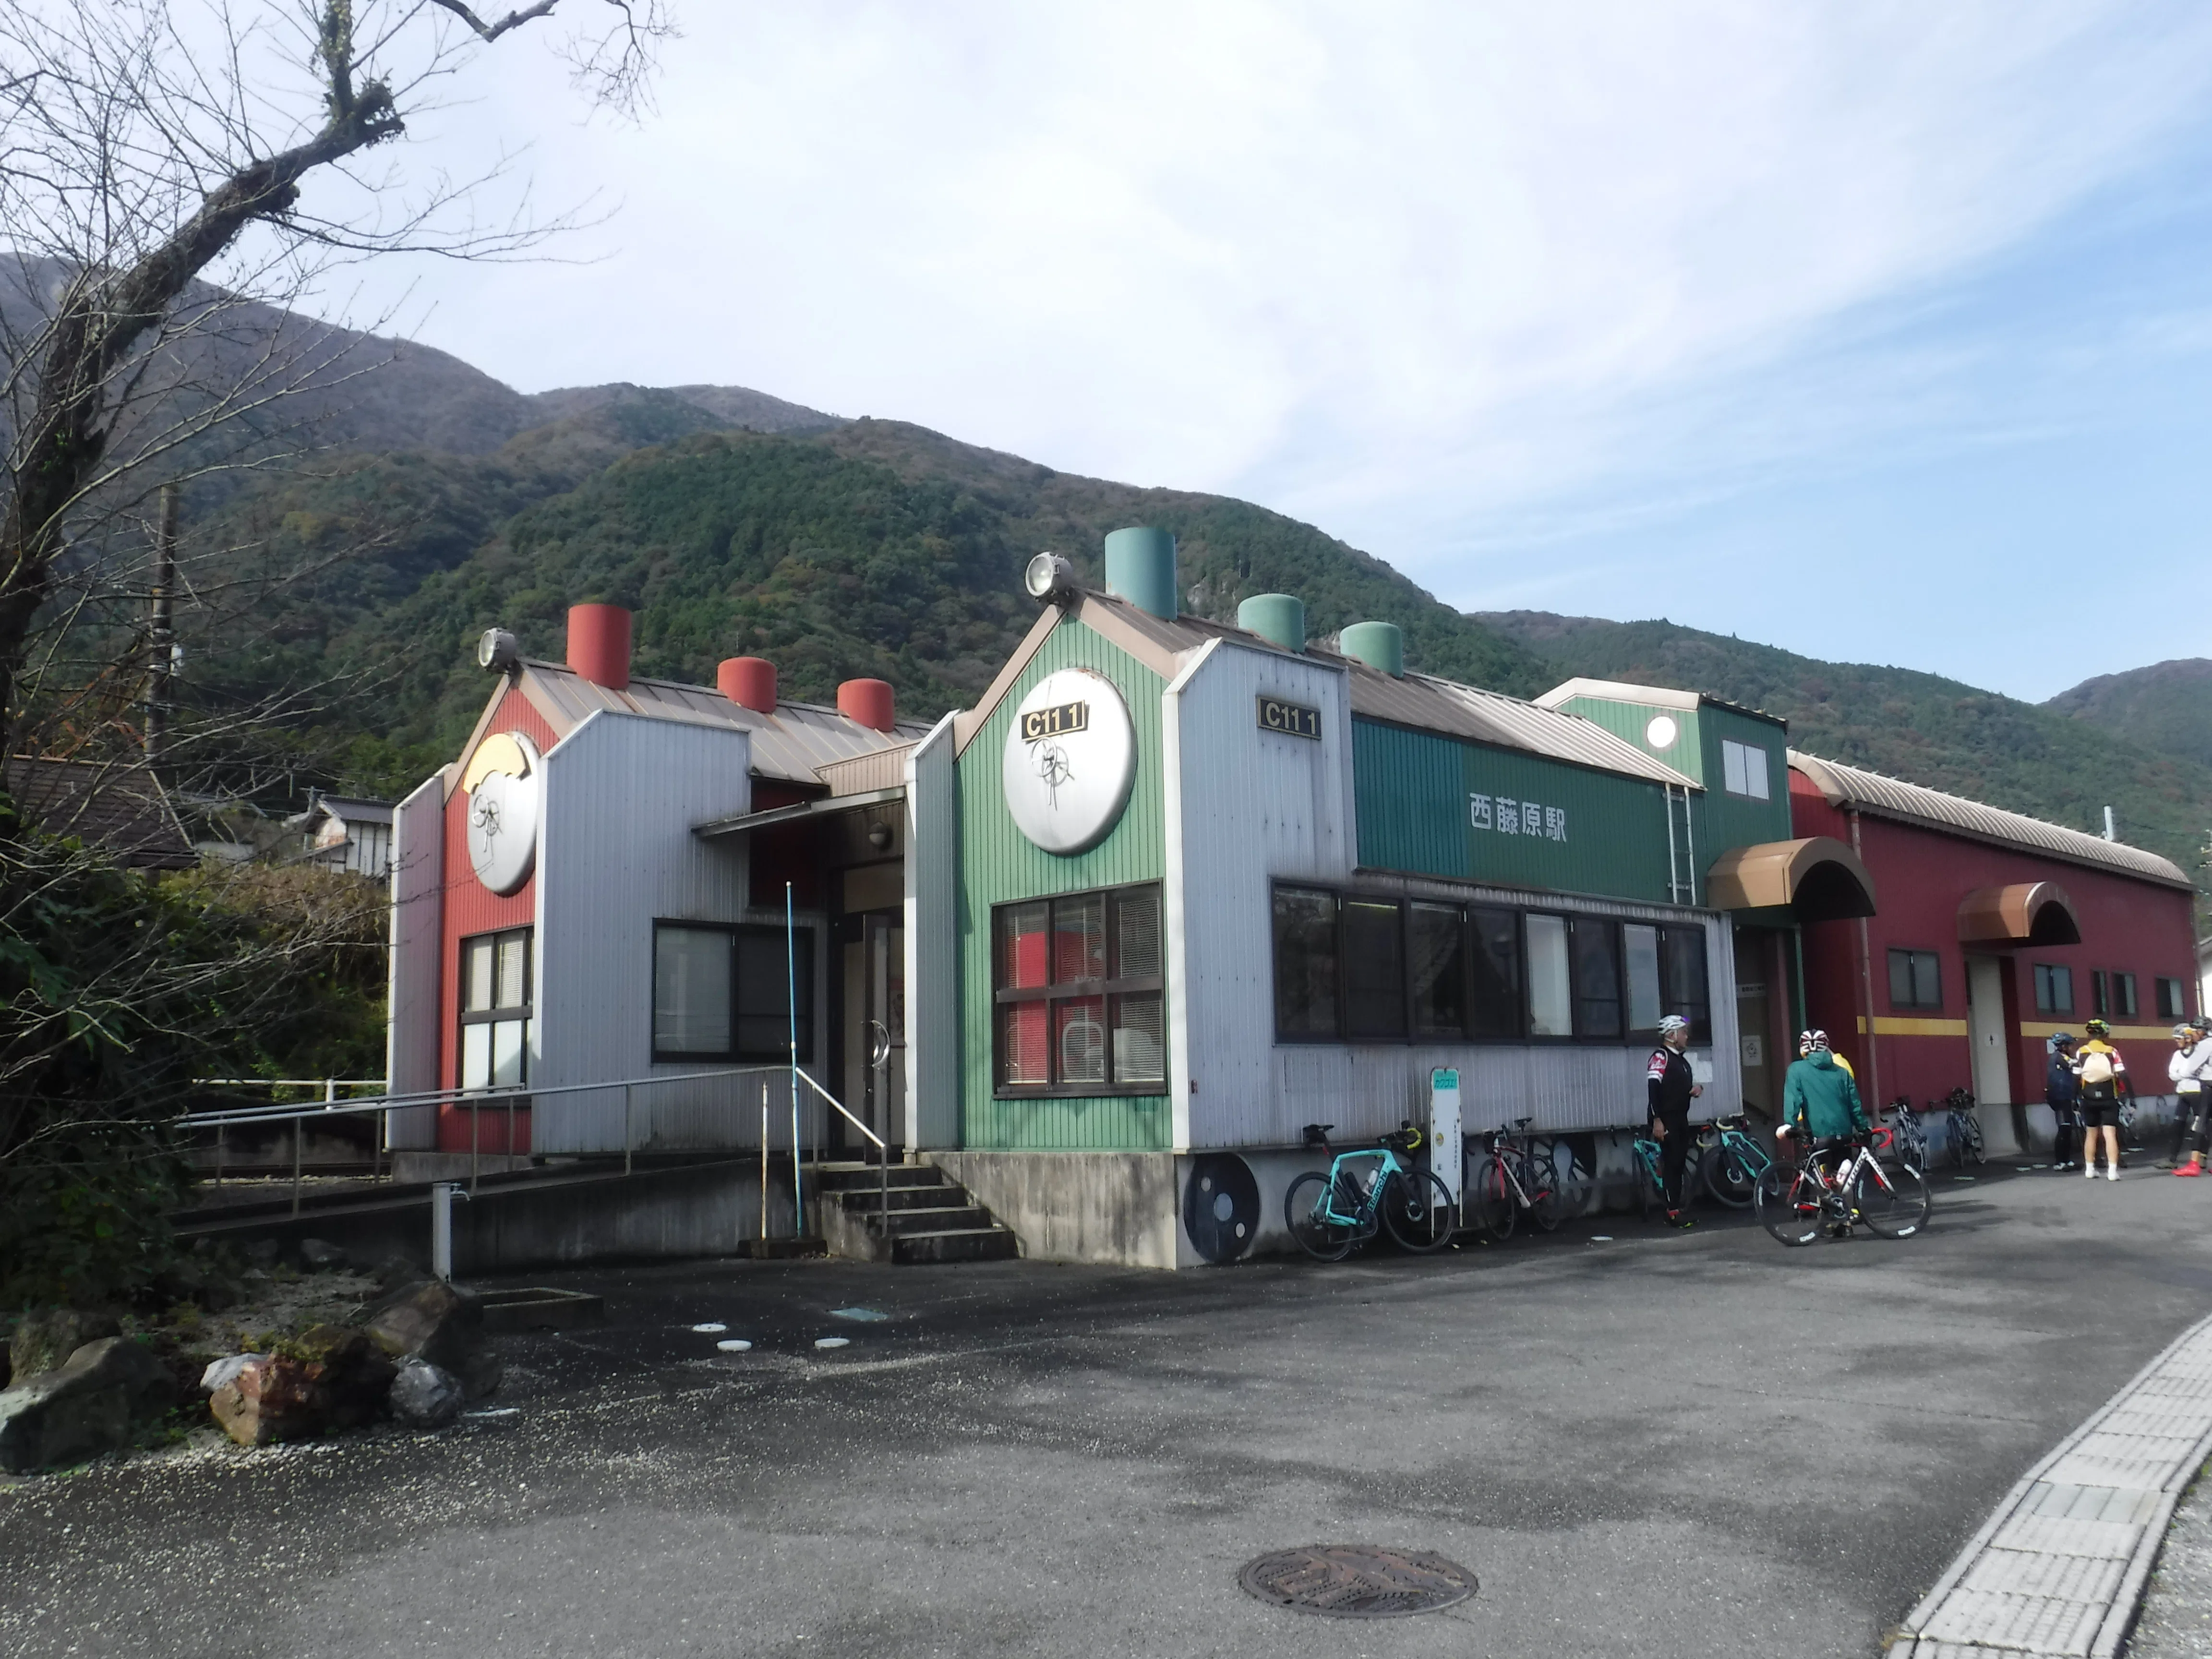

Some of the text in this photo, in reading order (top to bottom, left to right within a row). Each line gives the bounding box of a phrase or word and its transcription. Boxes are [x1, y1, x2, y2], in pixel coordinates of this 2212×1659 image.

[1026, 708, 1060, 736] C11
[1266, 702, 1299, 731] C11
[1469, 792, 1567, 842] 西藤原駅
[1369, 1170, 1387, 1210] Bianchi
